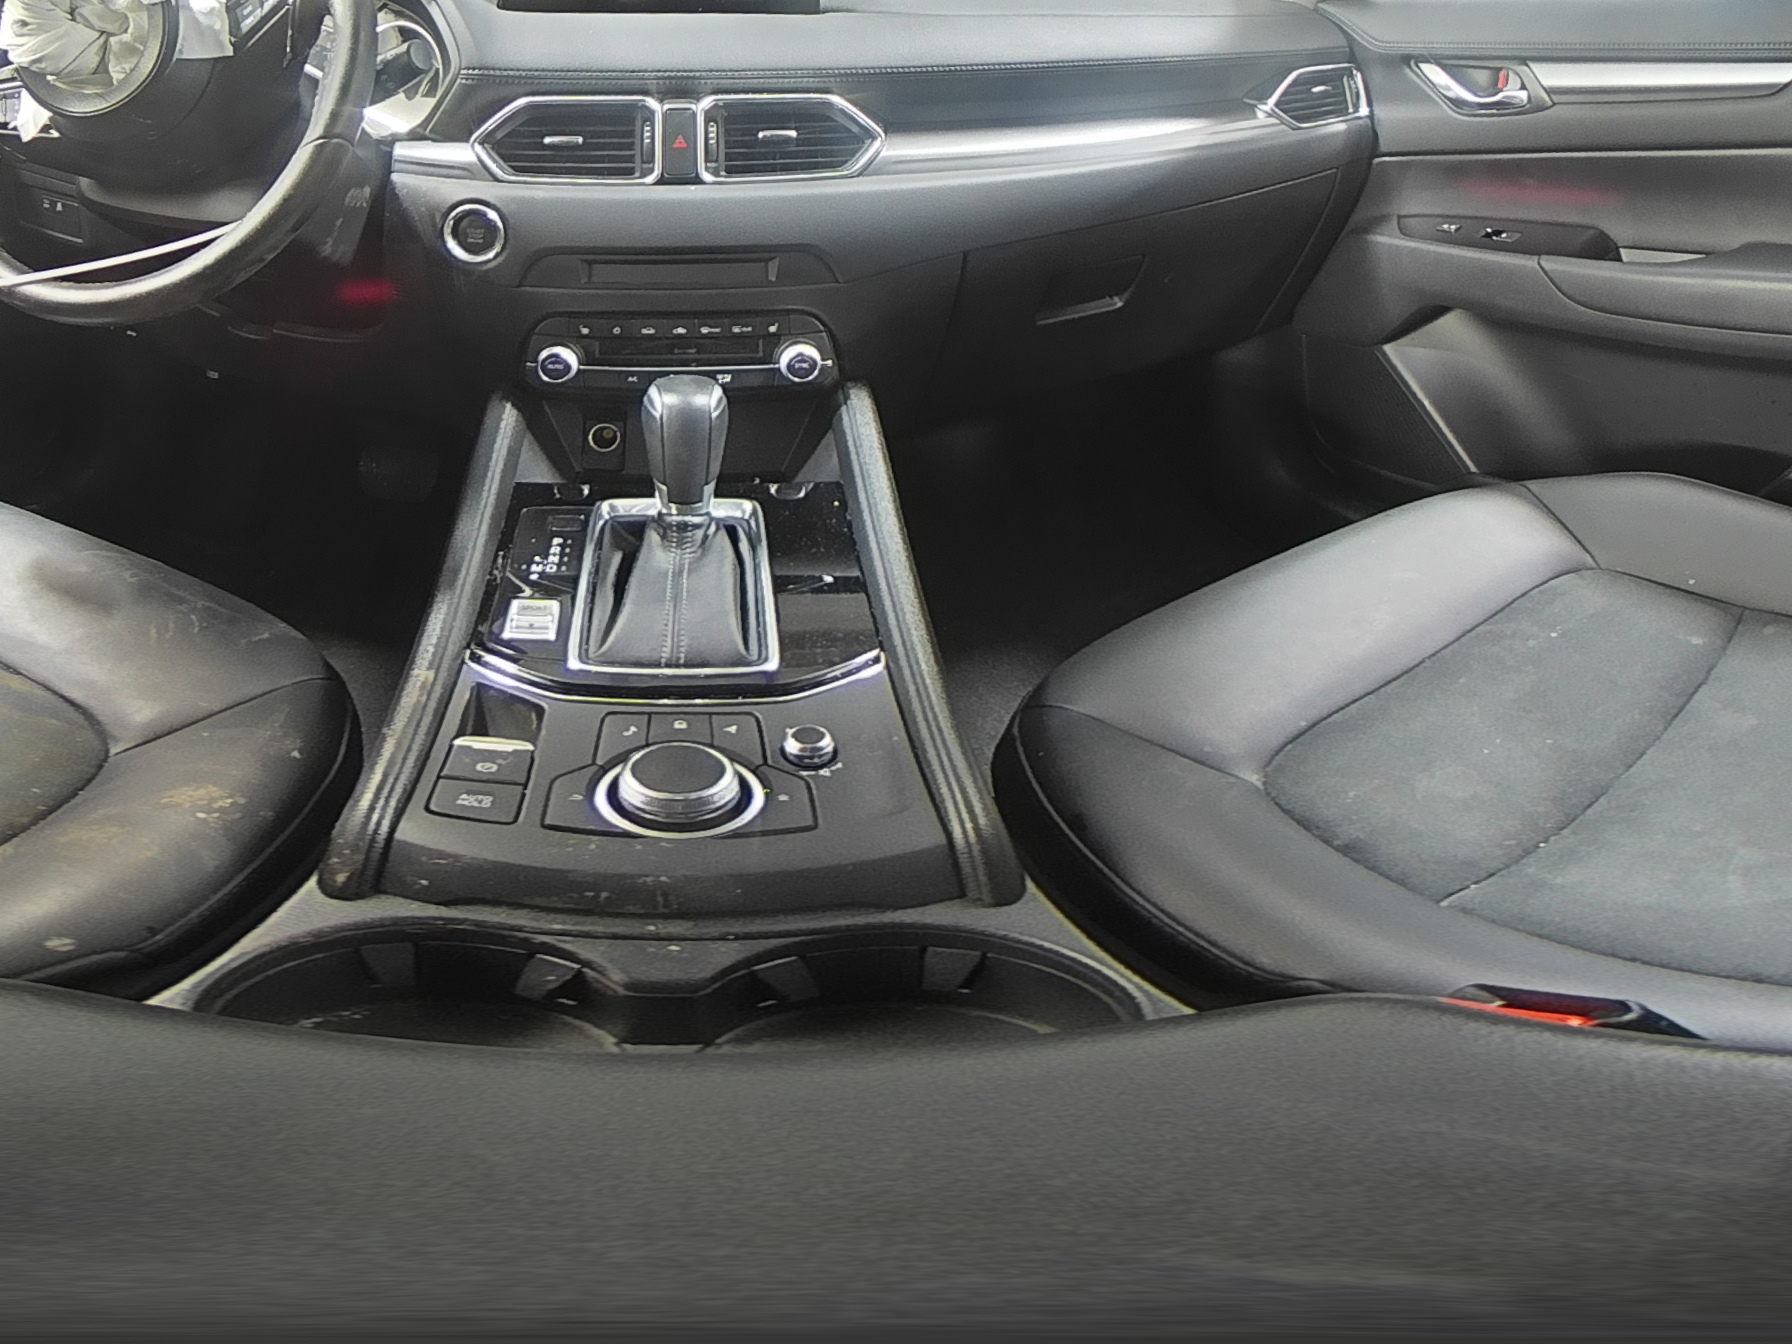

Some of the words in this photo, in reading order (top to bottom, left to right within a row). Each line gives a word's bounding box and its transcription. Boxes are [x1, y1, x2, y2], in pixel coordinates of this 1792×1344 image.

[551, 537, 564, 546] P
[549, 546, 561, 554] R
[545, 563, 558, 573] D
[458, 793, 494, 801] AUTO
